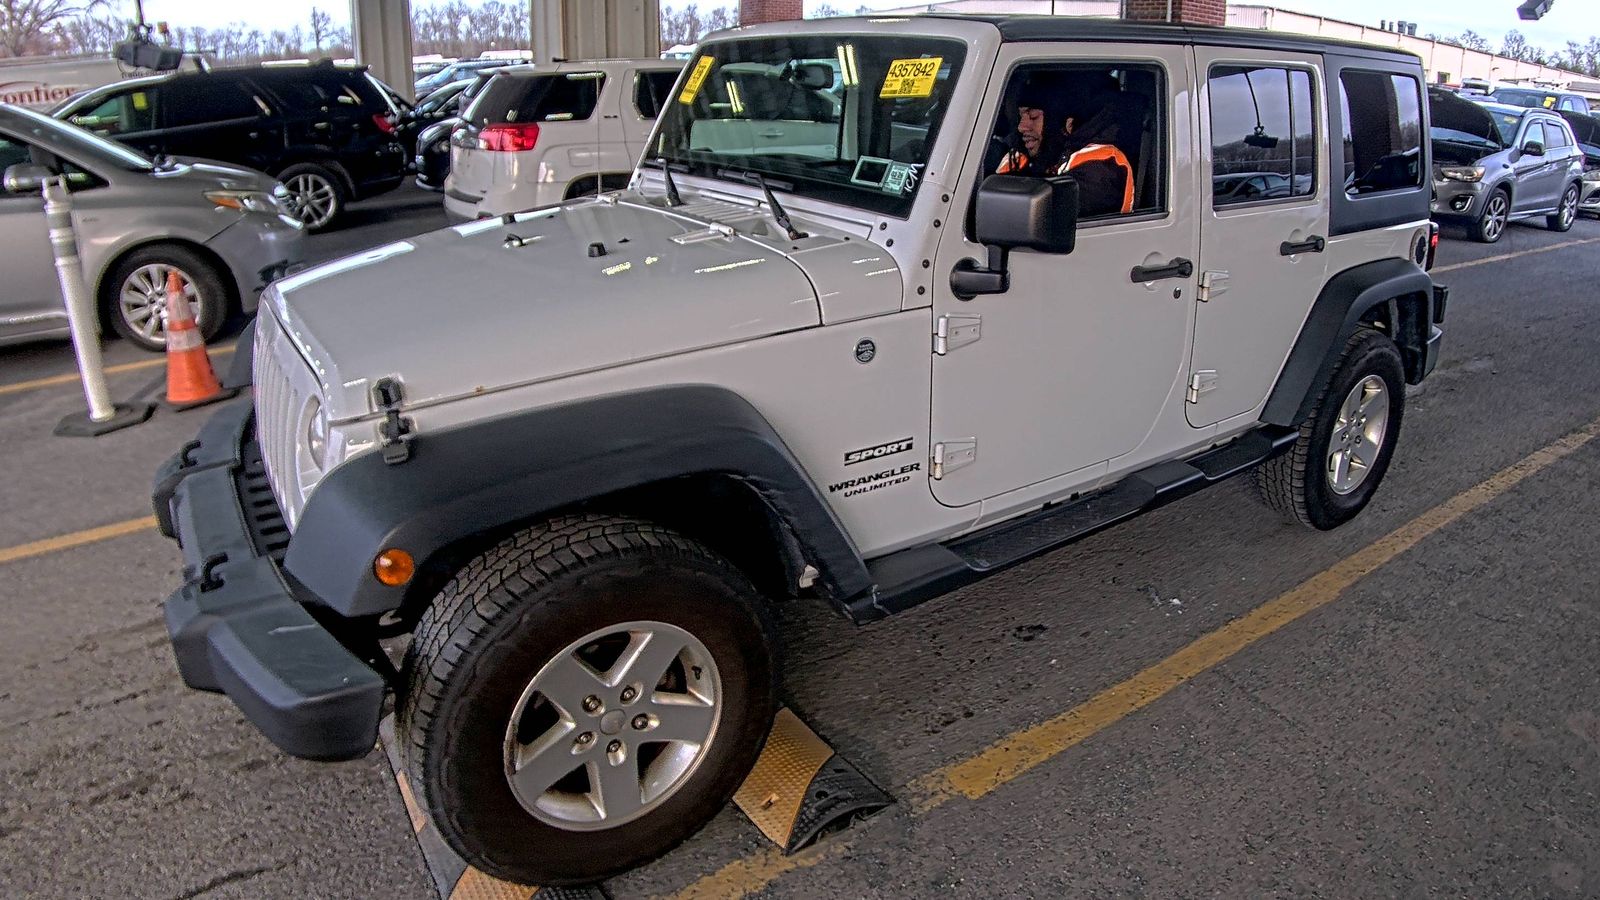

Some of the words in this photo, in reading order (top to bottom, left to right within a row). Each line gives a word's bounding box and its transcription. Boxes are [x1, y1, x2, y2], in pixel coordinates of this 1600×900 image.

[889, 62, 936, 78] 4357842
[0, 83, 77, 104] ontier
[847, 440, 913, 461] SPORT
[828, 462, 921, 493] WRANGLER
[843, 475, 911, 498] UNLIMITED
